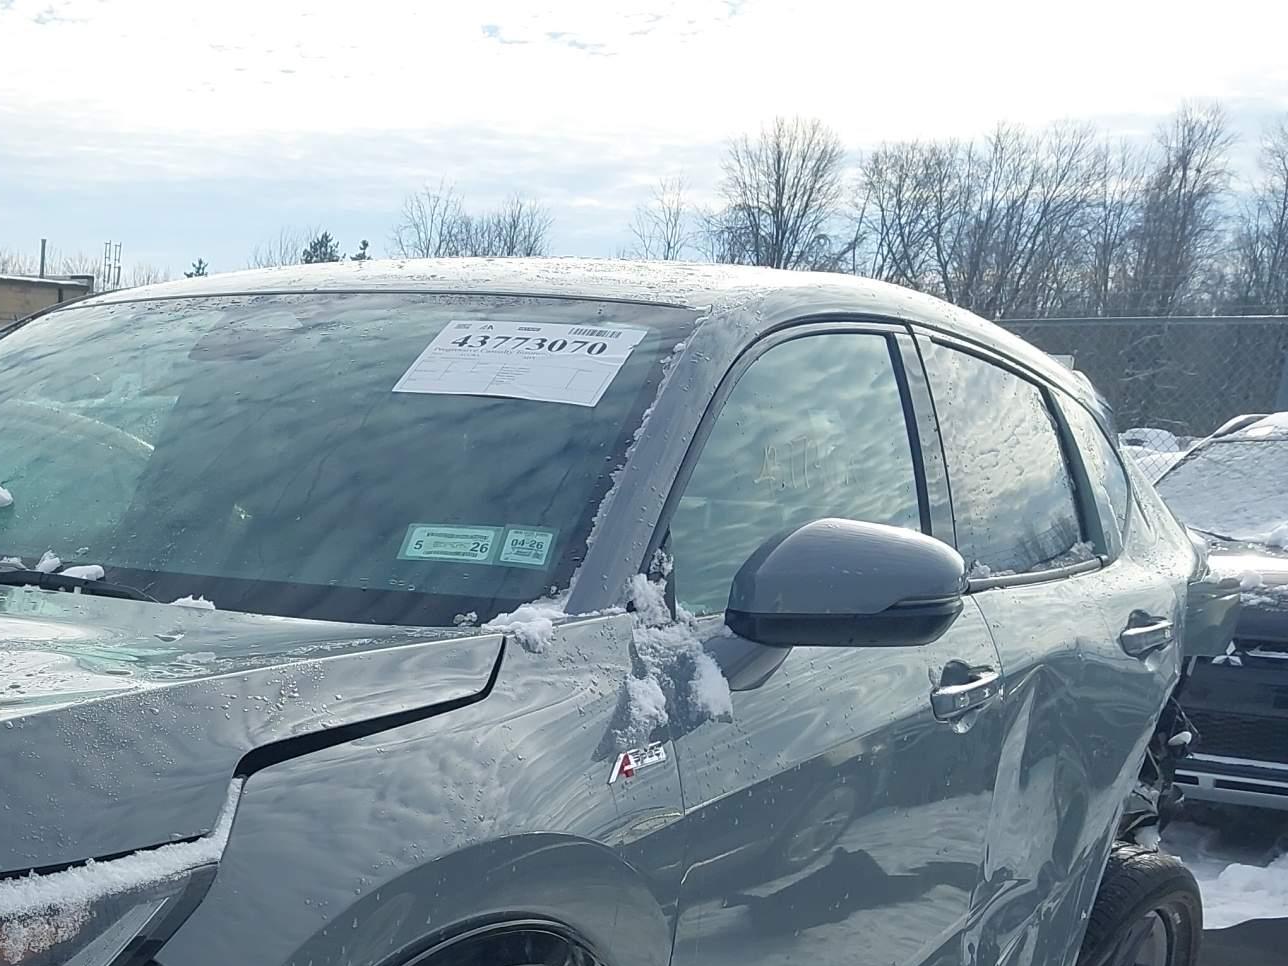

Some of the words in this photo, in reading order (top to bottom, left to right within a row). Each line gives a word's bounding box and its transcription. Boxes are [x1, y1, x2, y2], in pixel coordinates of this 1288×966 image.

[451, 334, 608, 356] 43773070
[413, 539, 424, 551] 5
[469, 541, 489, 554] 26
